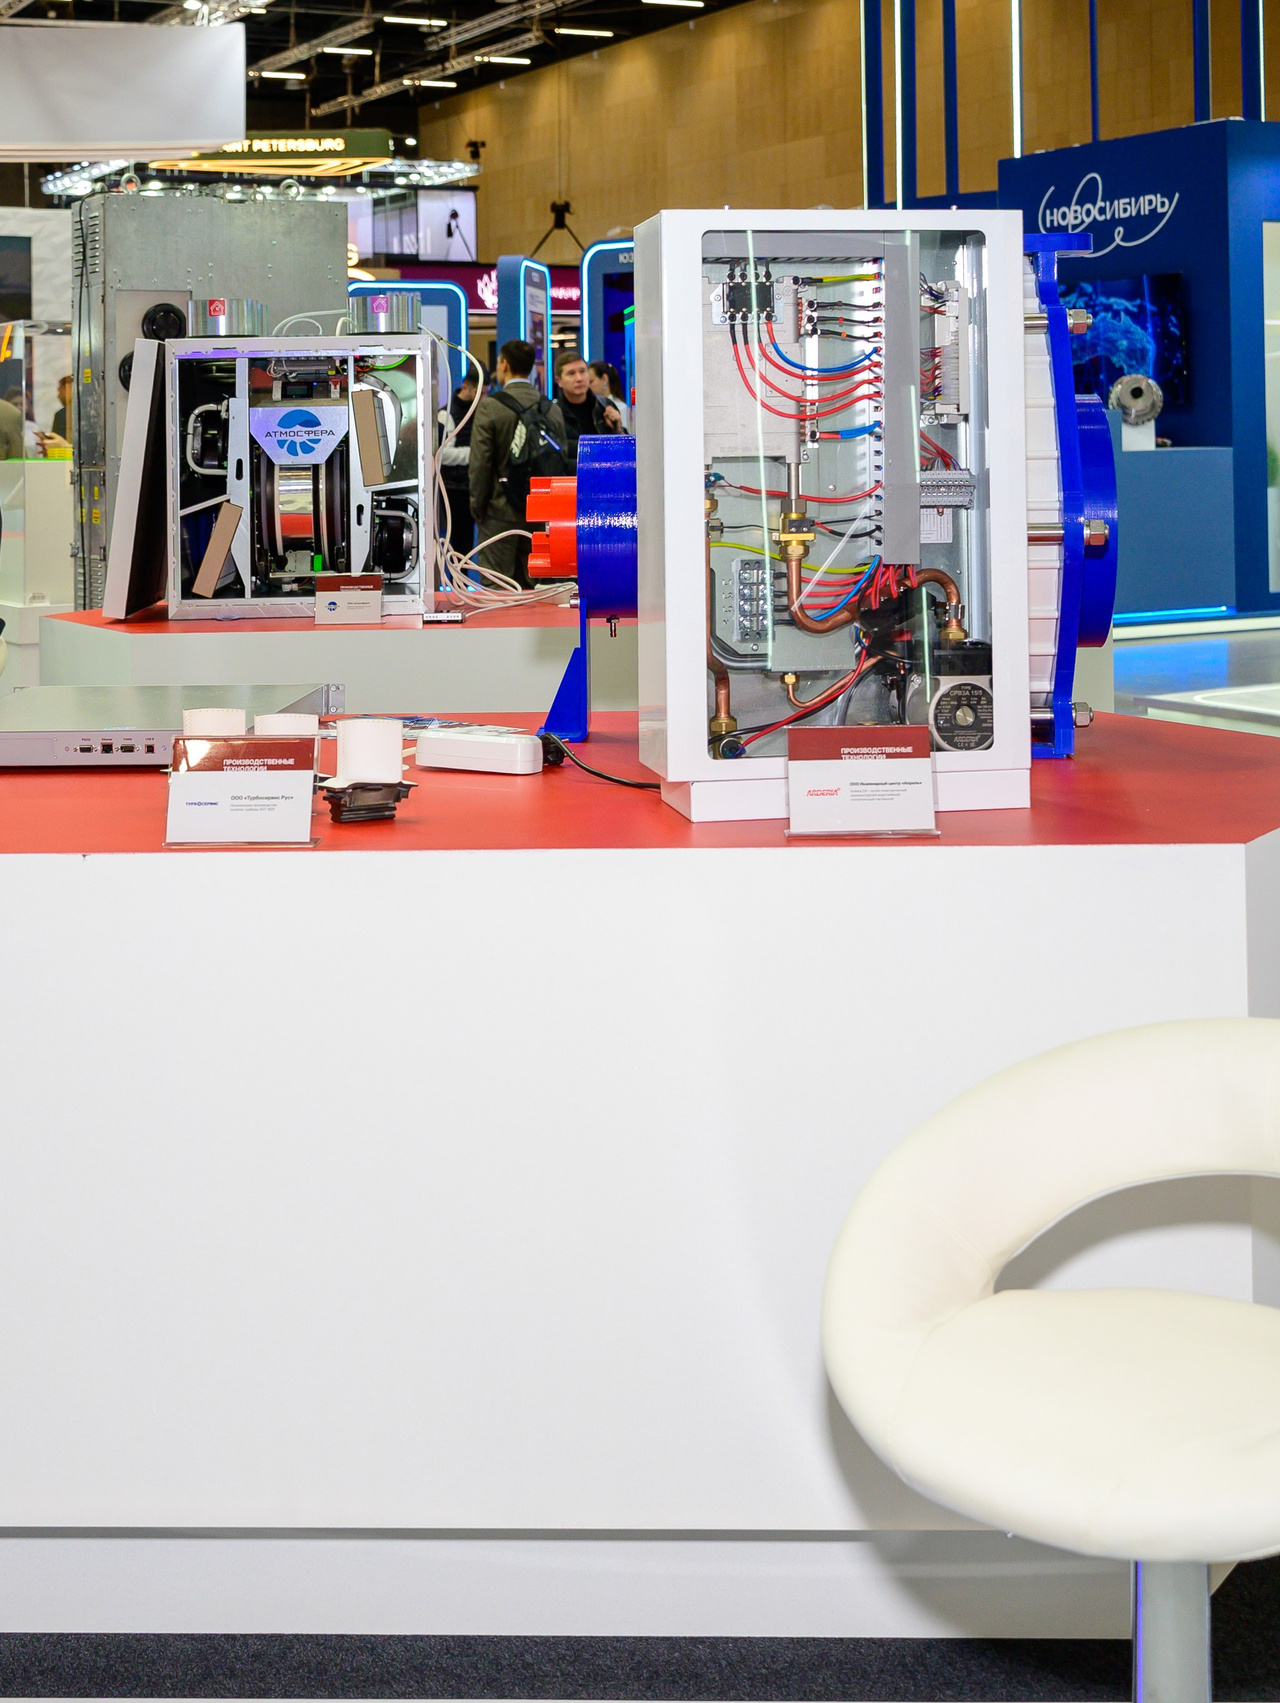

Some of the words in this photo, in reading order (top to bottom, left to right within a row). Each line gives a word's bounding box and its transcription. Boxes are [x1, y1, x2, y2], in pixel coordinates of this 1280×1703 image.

[252, 138, 345, 152] PETERSBURG
[1045, 193, 1170, 228] НОВОСИБИРЬ
[265, 429, 335, 438] АТМОСФЕРА
[223, 758, 295, 766] ПРОИЗВОДСТВЕННЫЕ
